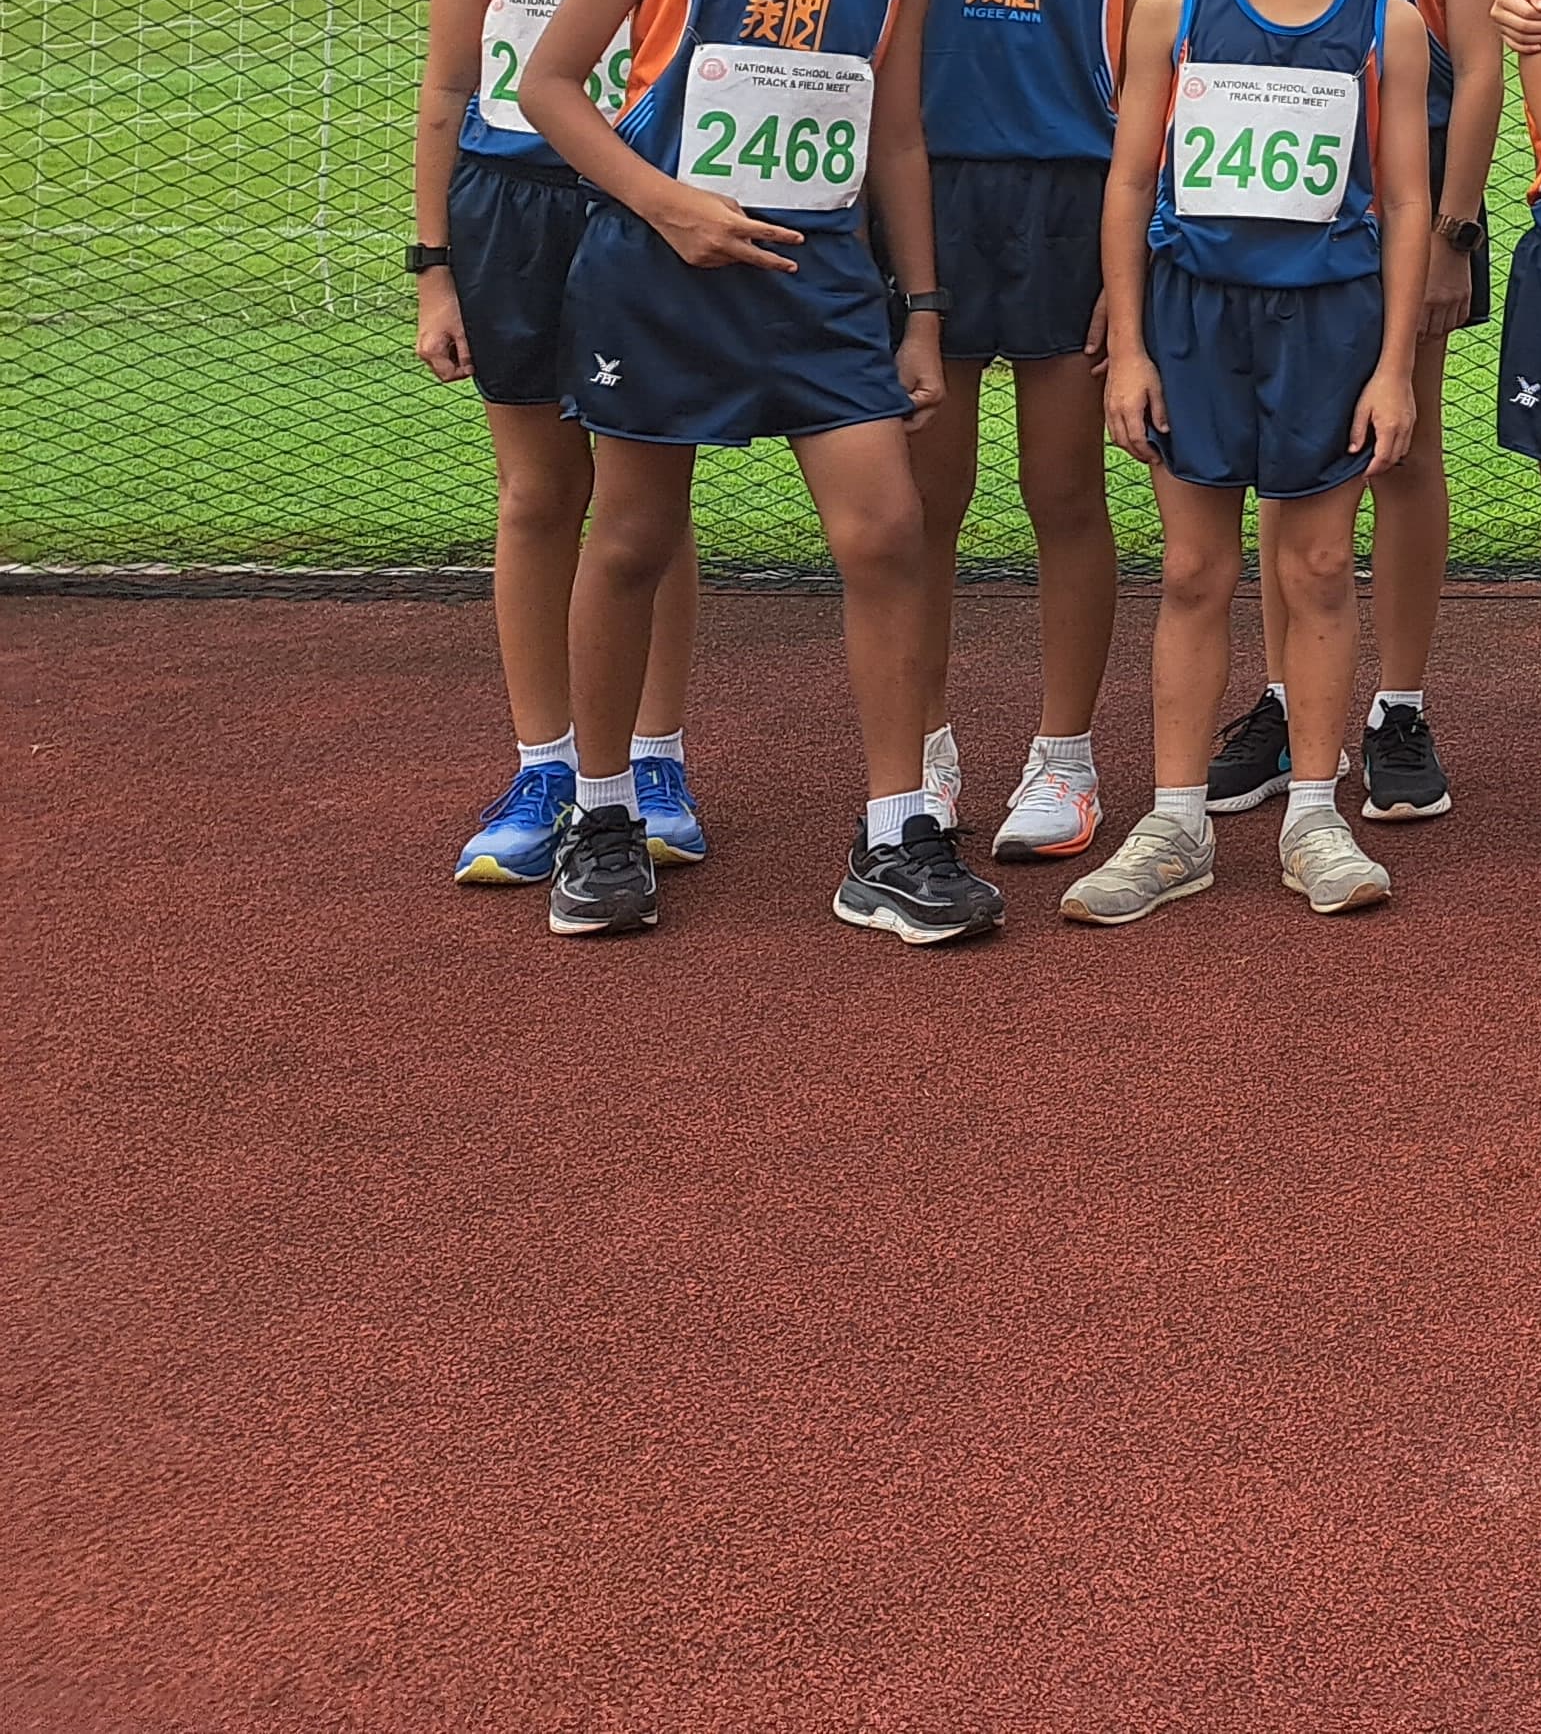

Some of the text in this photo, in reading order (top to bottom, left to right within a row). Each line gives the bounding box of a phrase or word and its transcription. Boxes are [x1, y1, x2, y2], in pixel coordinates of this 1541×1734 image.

[525, 8, 556, 18] TRAC
[963, 6, 1042, 23] NGEE ANN
[734, 63, 865, 82] NATIONAL SCHOOL GAMES
[752, 76, 850, 93] TRACK & FIELD MEET
[1213, 80, 1346, 98] NATIONAL SCHOOL GAMES
[1228, 92, 1329, 108] TRACK & FIELD MEET
[690, 110, 856, 185] 2468
[1182, 126, 1341, 196] 2465
